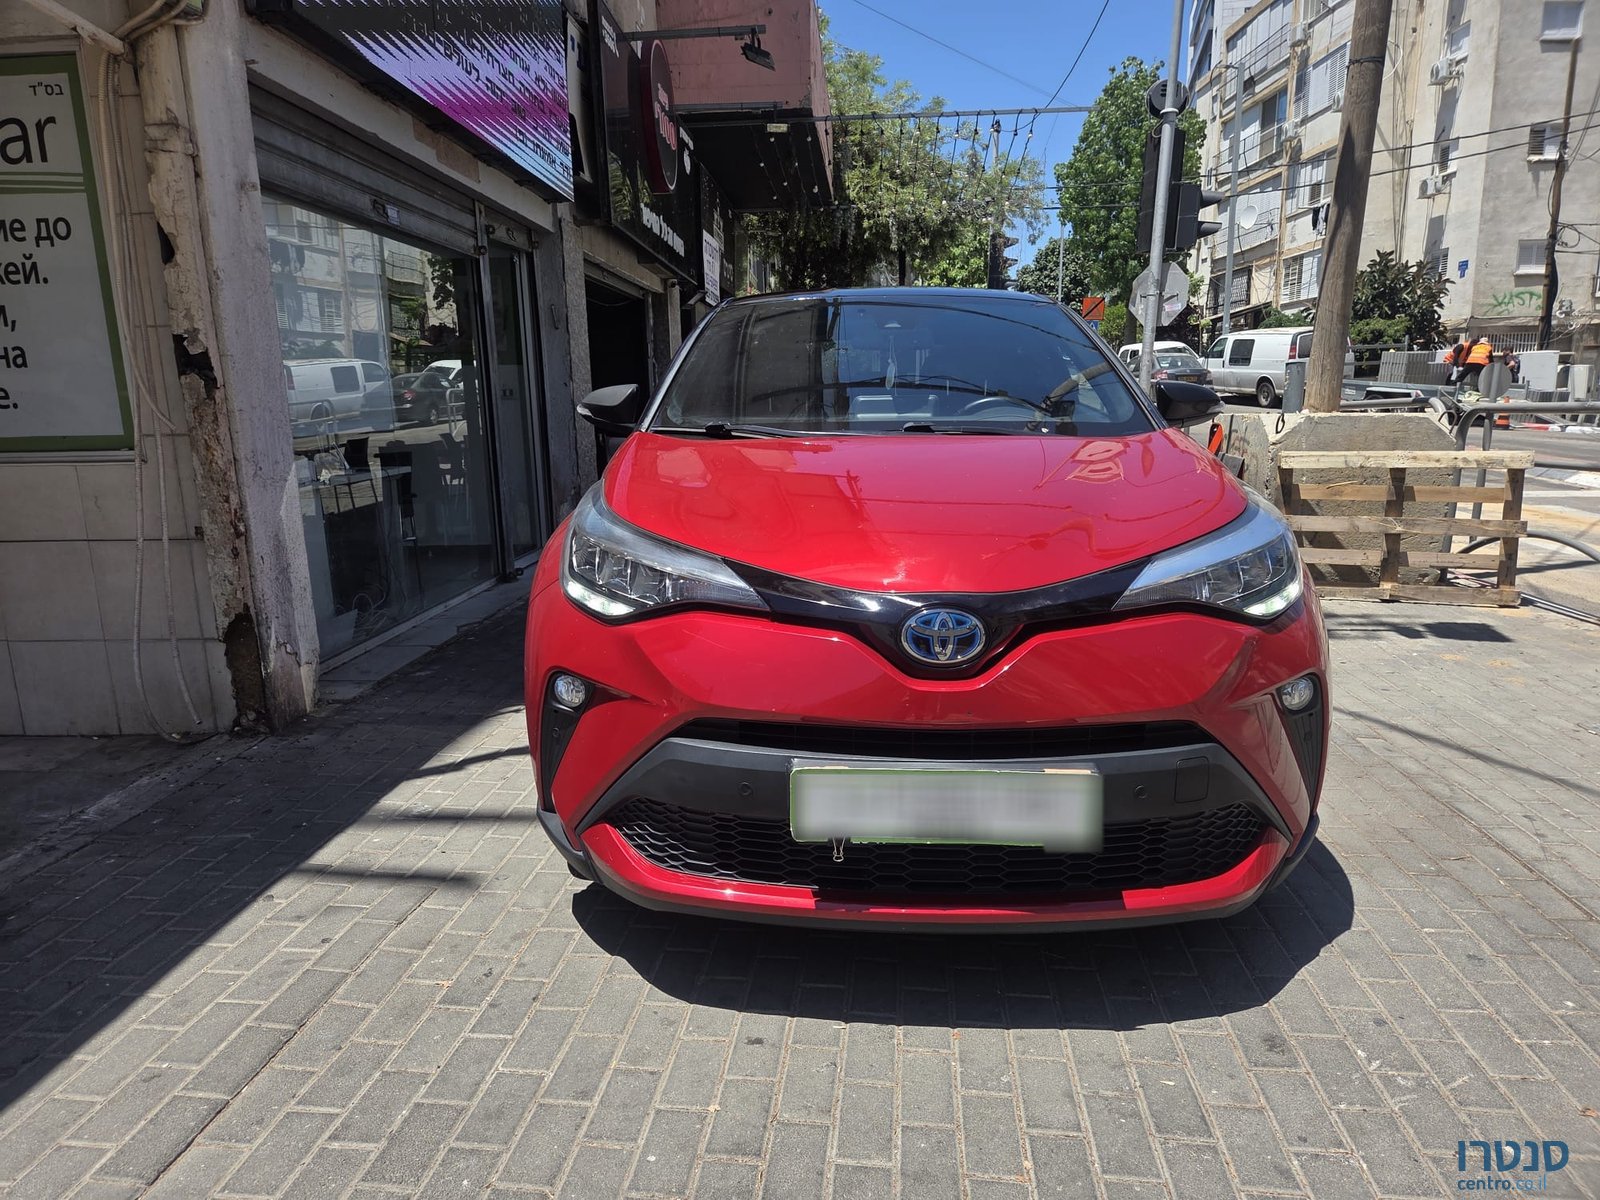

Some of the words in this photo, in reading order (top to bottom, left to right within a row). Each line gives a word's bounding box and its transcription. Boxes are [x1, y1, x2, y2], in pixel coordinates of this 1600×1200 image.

[28, 82, 64, 96] בס"ד
[0, 116, 56, 165] ar
[35, 217, 72, 248] до
[0, 253, 49, 285] ей.
